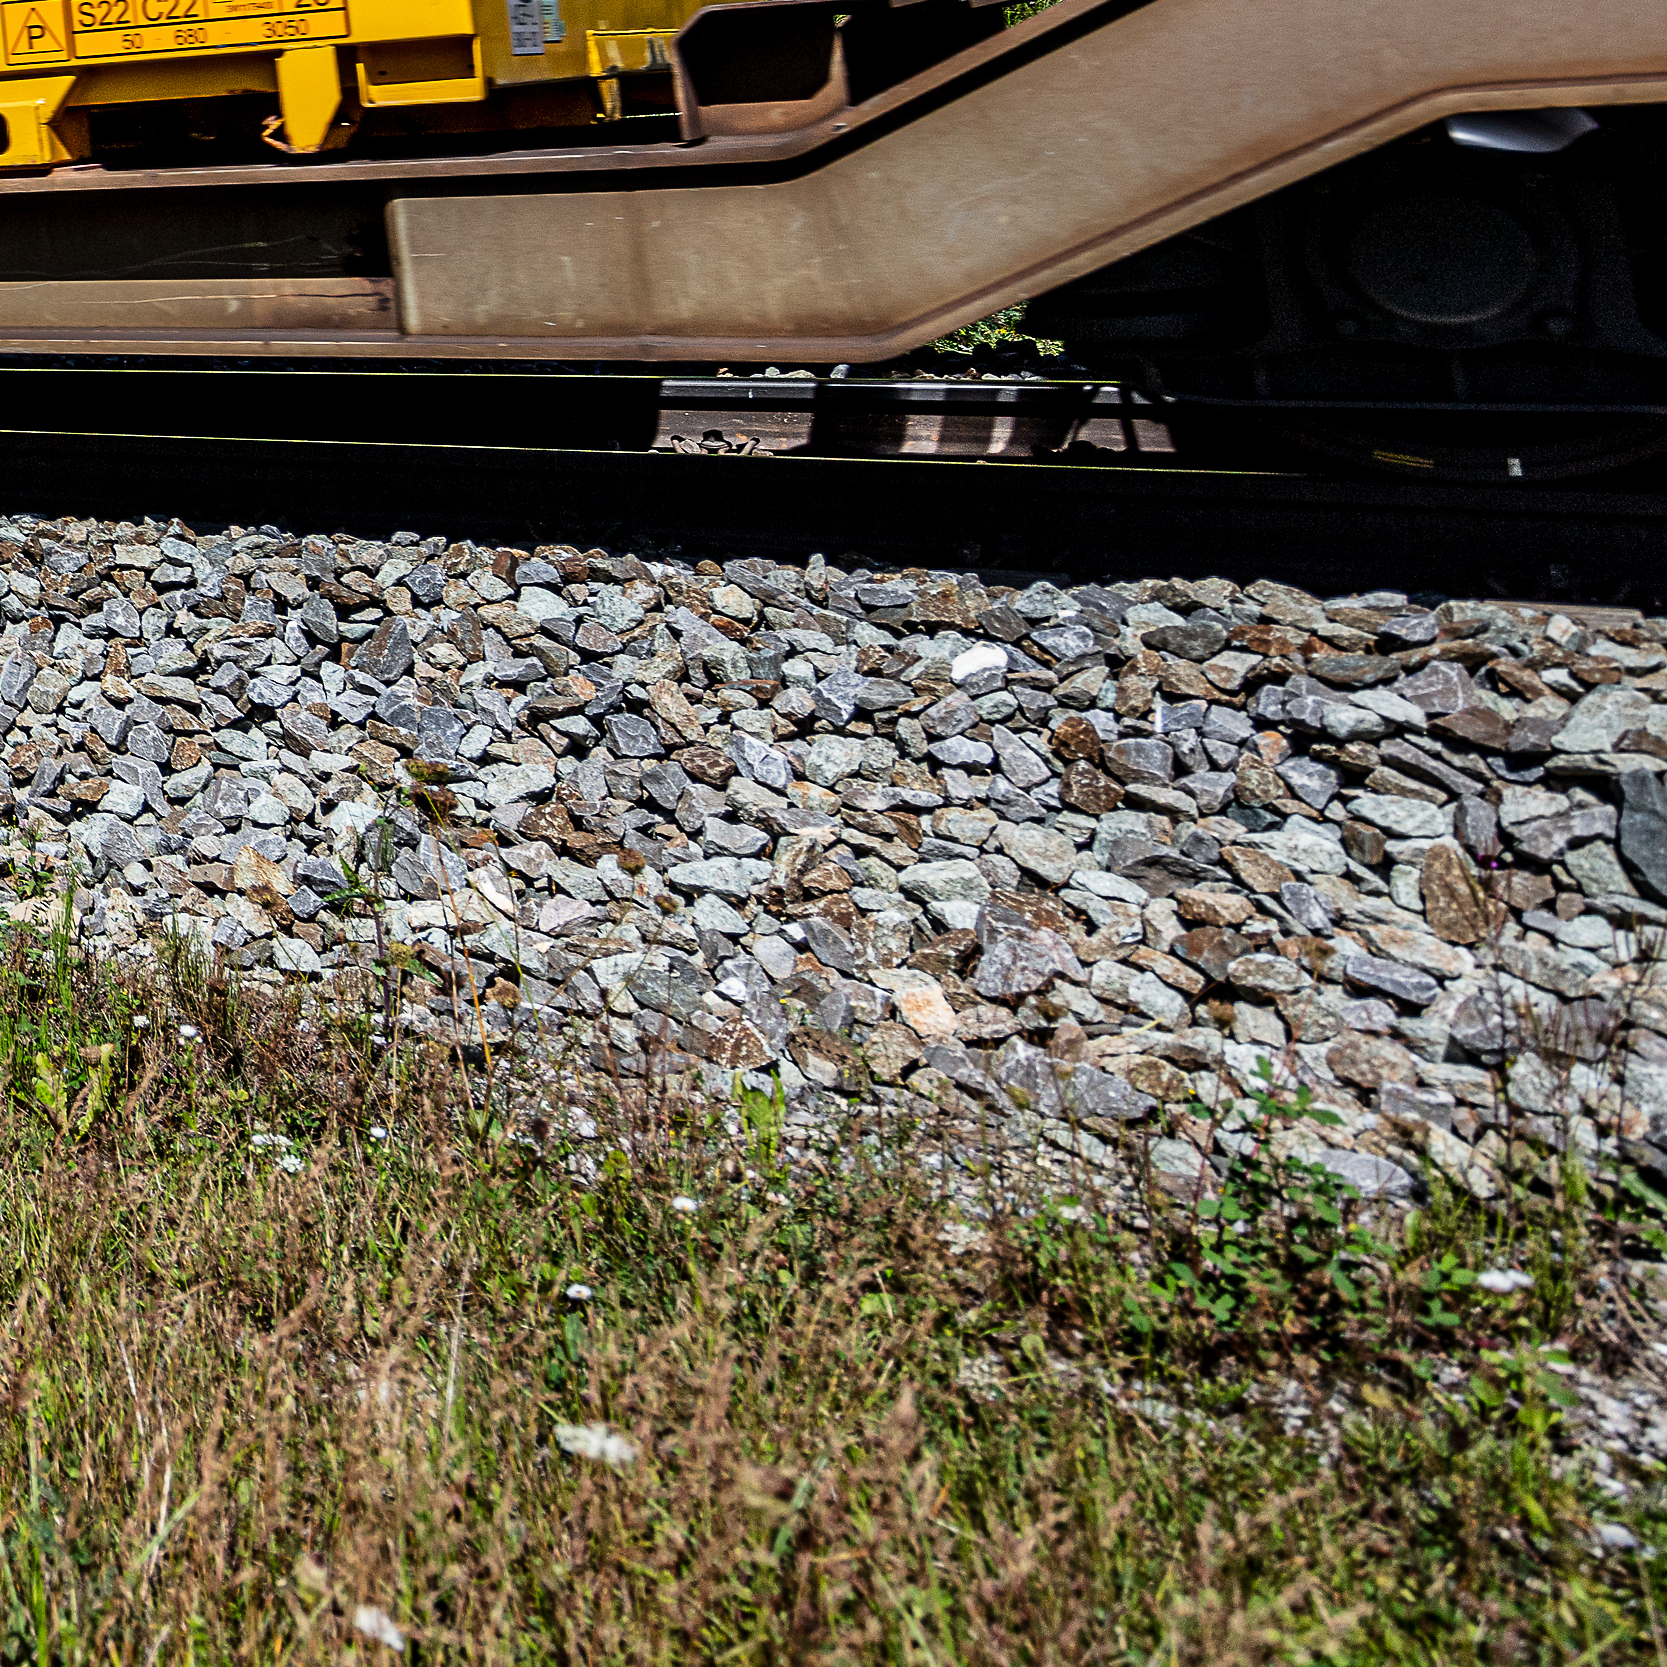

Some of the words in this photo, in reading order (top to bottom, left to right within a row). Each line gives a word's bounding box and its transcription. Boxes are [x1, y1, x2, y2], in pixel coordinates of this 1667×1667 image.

[77, 0, 131, 28] S22
[121, 33, 145, 50] 50
[174, 27, 208, 46] 680
[262, 18, 310, 39] 3050
